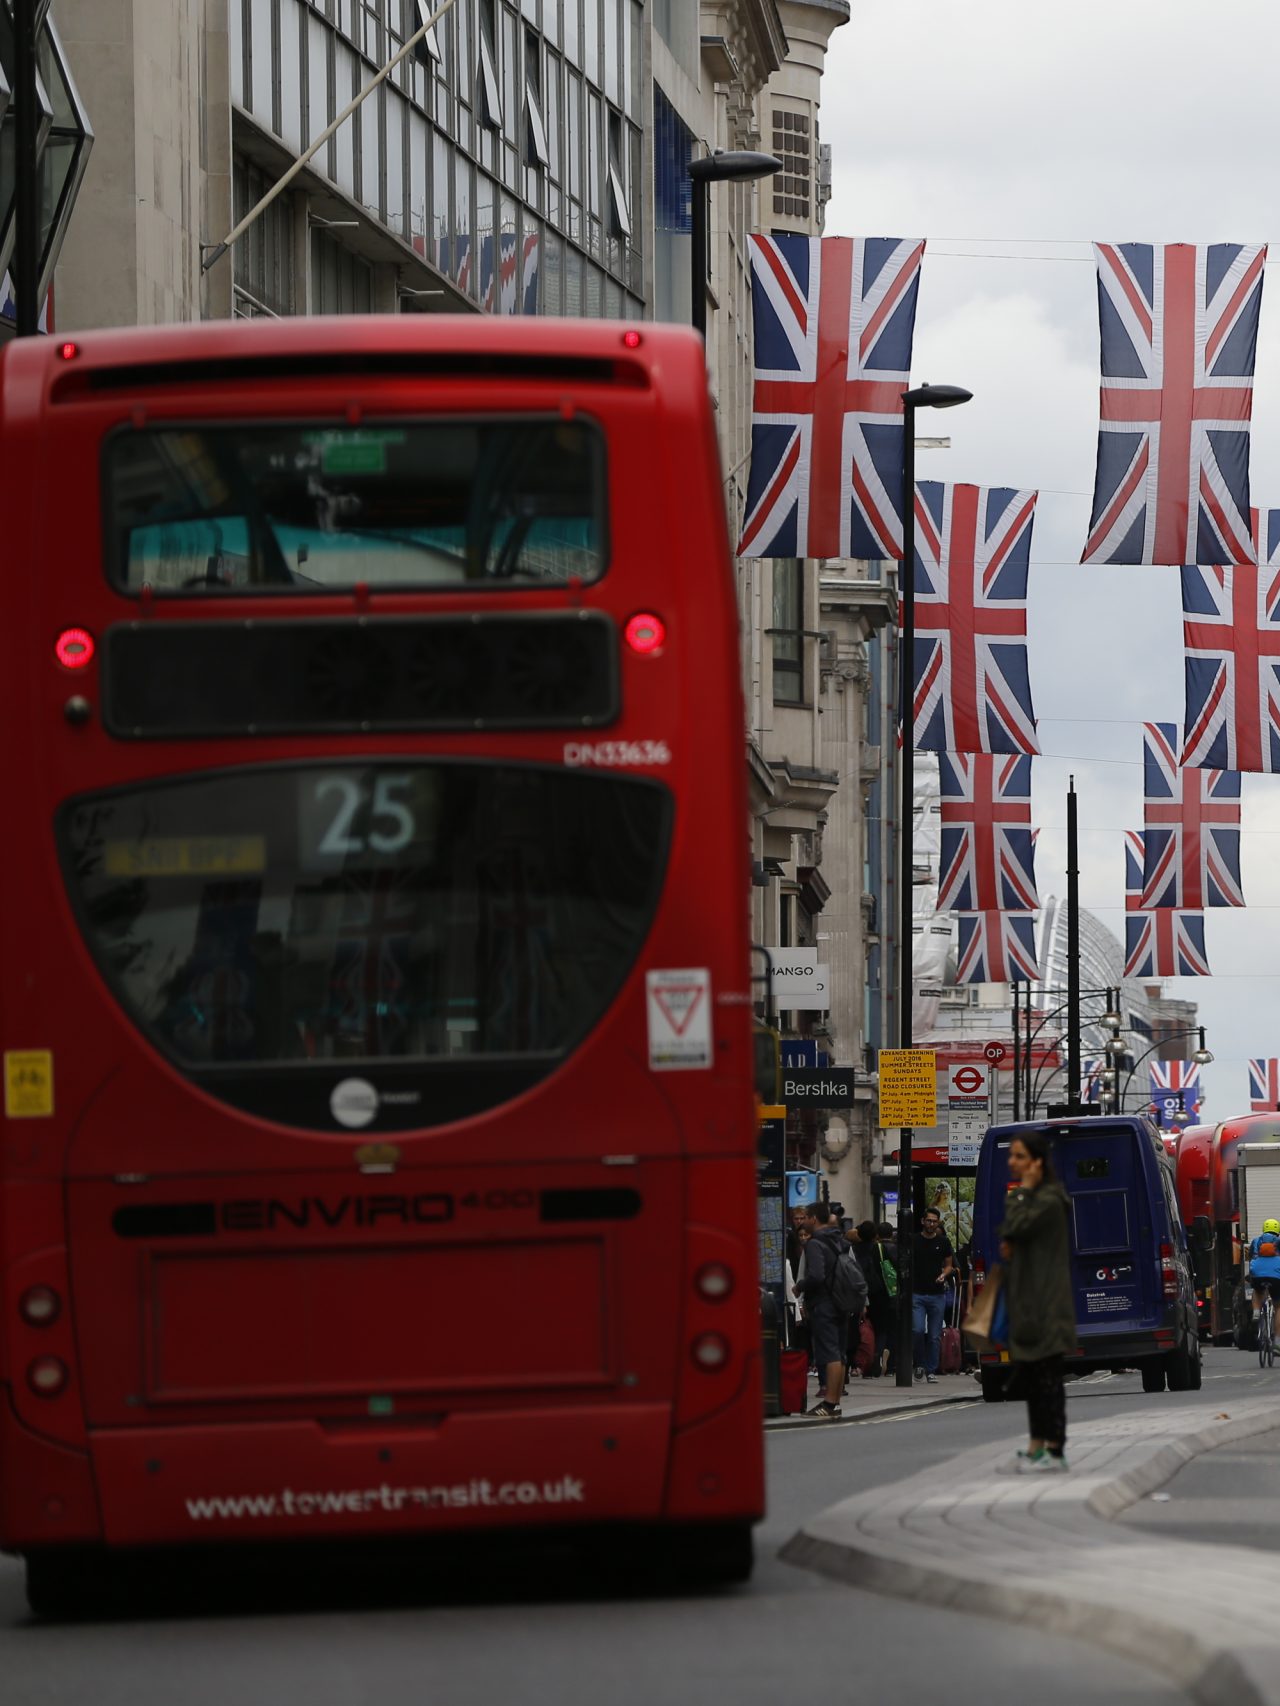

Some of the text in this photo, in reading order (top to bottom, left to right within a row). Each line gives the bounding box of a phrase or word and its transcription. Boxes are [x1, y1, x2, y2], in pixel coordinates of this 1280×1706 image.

[315, 775, 416, 853] 25
[765, 966, 814, 976] MANGO
[986, 1048, 1003, 1058] OP
[784, 1081, 848, 1096] Bershka
[222, 1188, 535, 1231] ENVIRO 400
[186, 1475, 586, 1520] www.towertransit.co.uk
